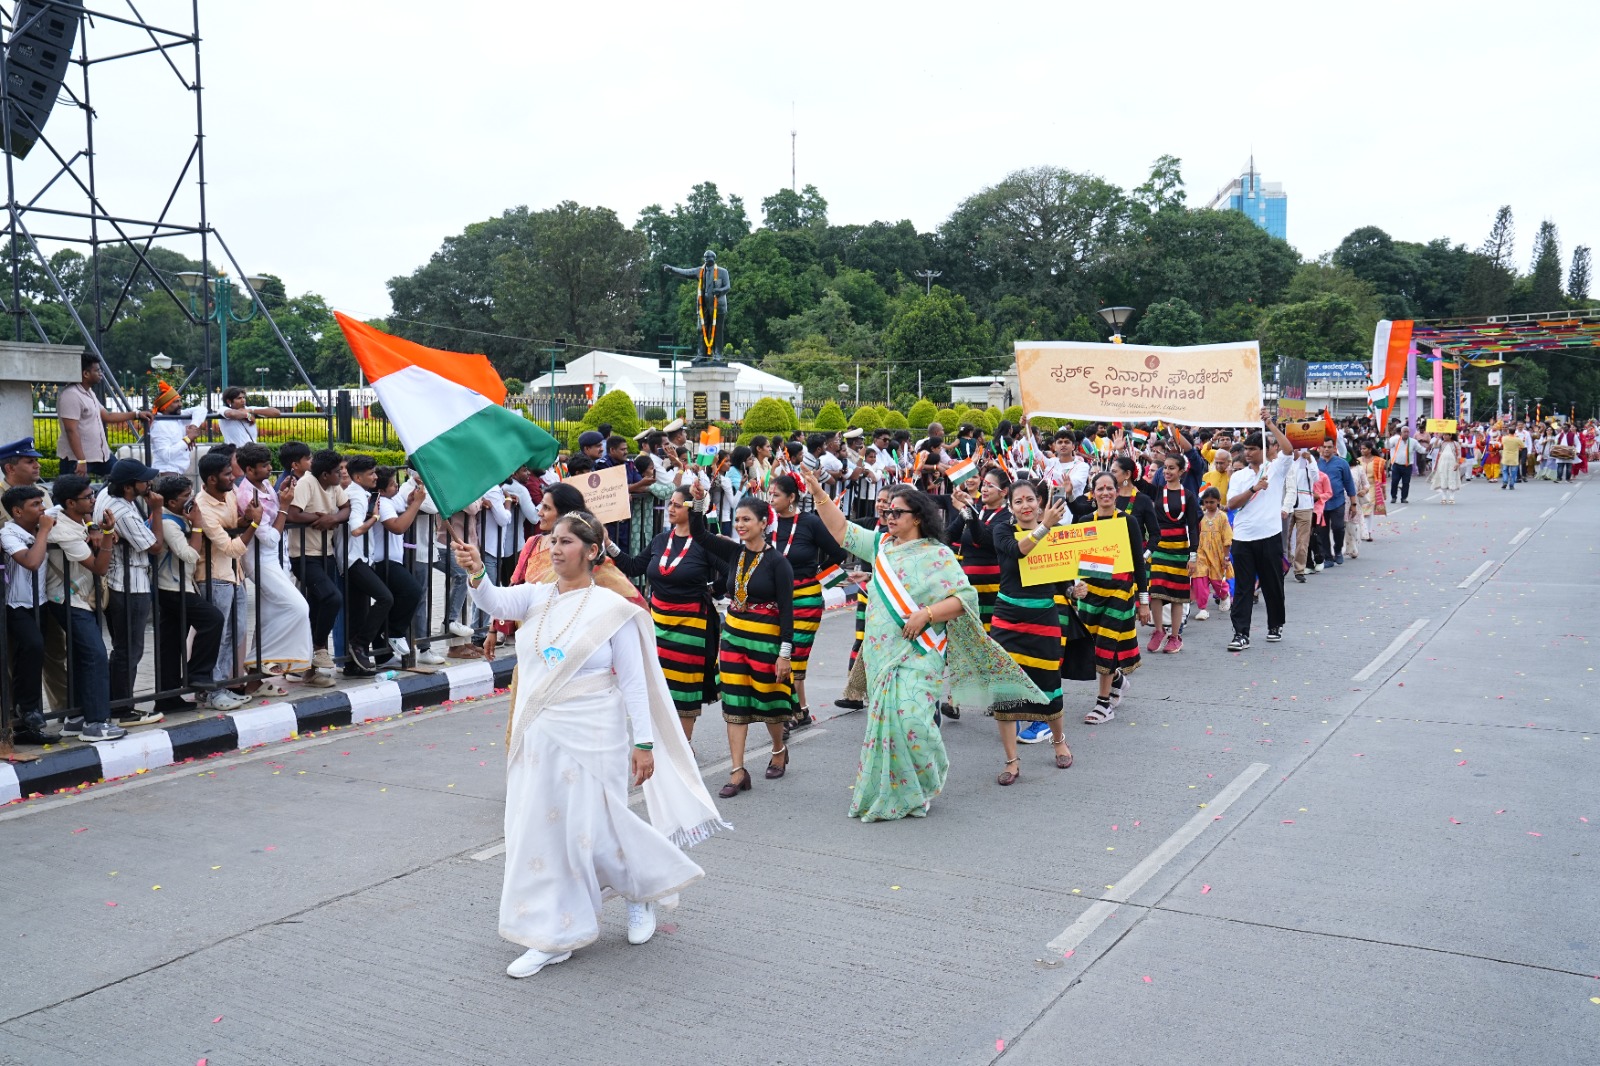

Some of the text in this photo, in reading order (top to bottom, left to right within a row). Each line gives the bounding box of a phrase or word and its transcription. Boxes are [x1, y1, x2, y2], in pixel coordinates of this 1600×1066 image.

[1105, 366, 1158, 383] ನಿನಾದ್
[1167, 368, 1233, 387] ಫೌಂಡೇಶನ್
[1088, 380, 1205, 400] SparshNinaad
[1027, 550, 1073, 565] NORTH EAST
